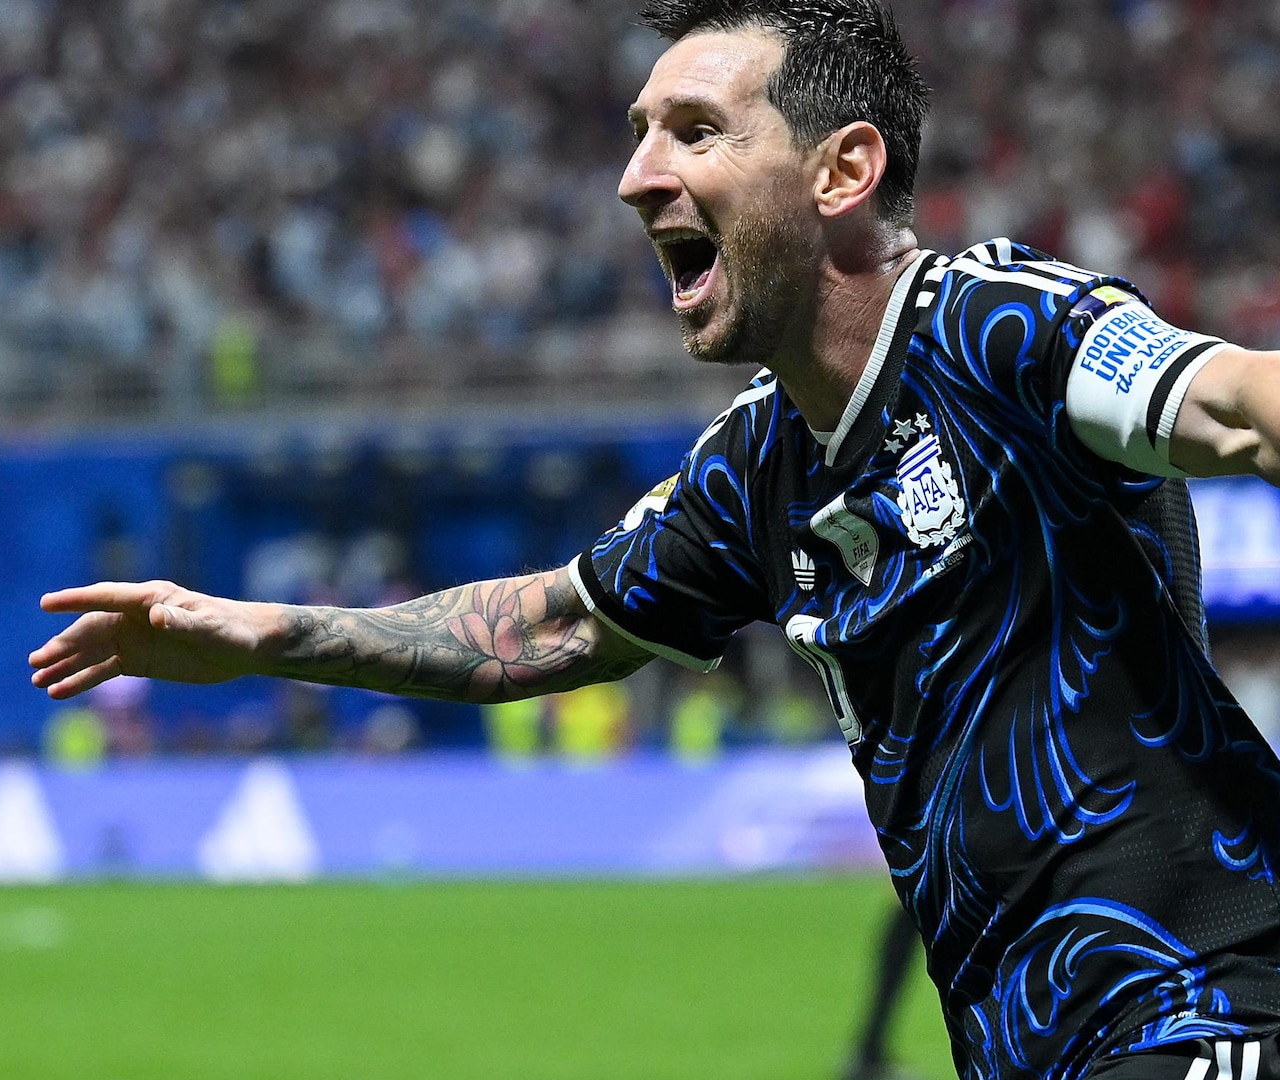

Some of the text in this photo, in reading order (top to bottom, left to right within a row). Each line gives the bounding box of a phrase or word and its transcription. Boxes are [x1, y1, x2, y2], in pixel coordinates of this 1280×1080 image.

[1080, 310, 1154, 372] FOOTBALL
[1096, 320, 1175, 382] UNITES
[1116, 330, 1192, 395] the Wor
[910, 466, 946, 516] AFA
[852, 541, 871, 561] FIFA
[946, 550, 965, 566] 2026
